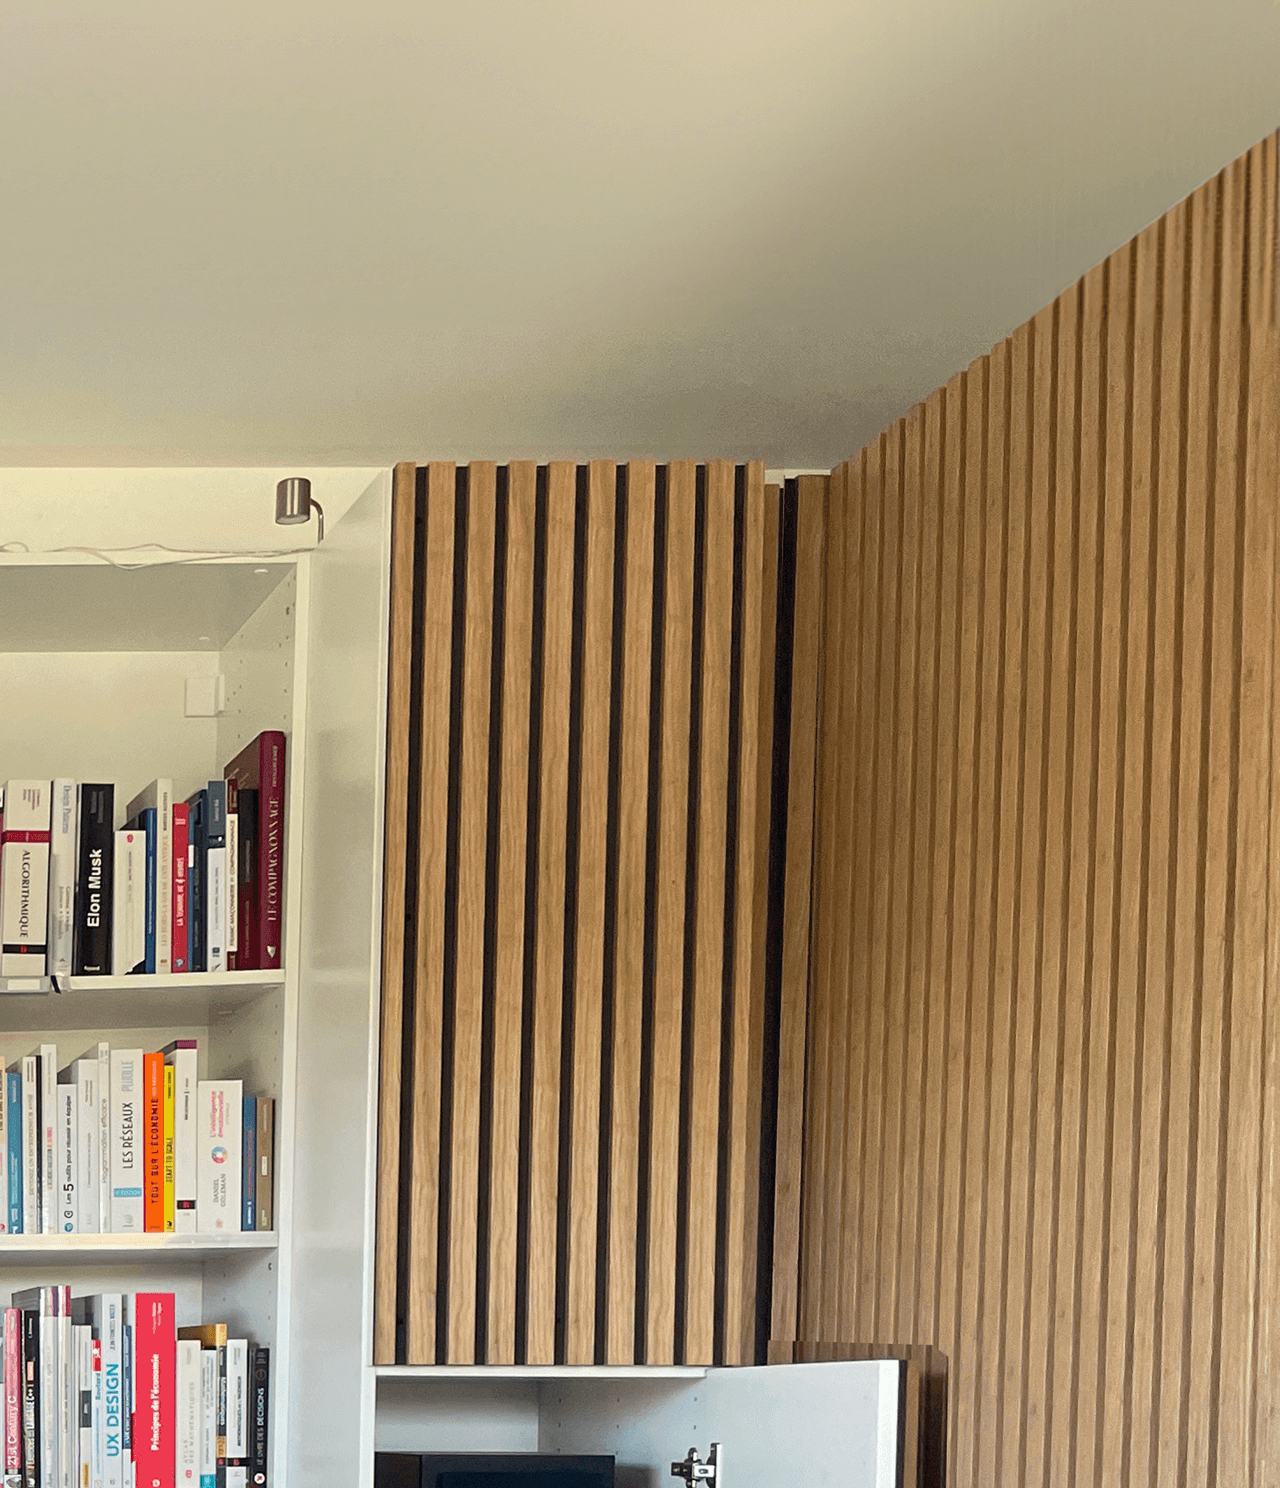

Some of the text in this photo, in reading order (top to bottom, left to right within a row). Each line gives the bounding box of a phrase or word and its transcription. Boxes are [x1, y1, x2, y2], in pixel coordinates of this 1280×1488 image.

[19, 850, 30, 938] ALGORITHMIQUE
[87, 849, 102, 927] Elon Musk
[268, 907, 277, 921] LE
[119, 1102, 133, 1169] LES RÉSEAUX
[63, 1183, 74, 1192] 5
[150, 1158, 159, 1204] TOUT SUR
[106, 1364, 119, 1427] DESIGN
[150, 1354, 161, 1451] Principes de l'économie
[255, 1388, 265, 1440] DES DÉCISIONS
[8, 1395, 17, 1466] 21st C
[106, 1433, 119, 1457] UX
